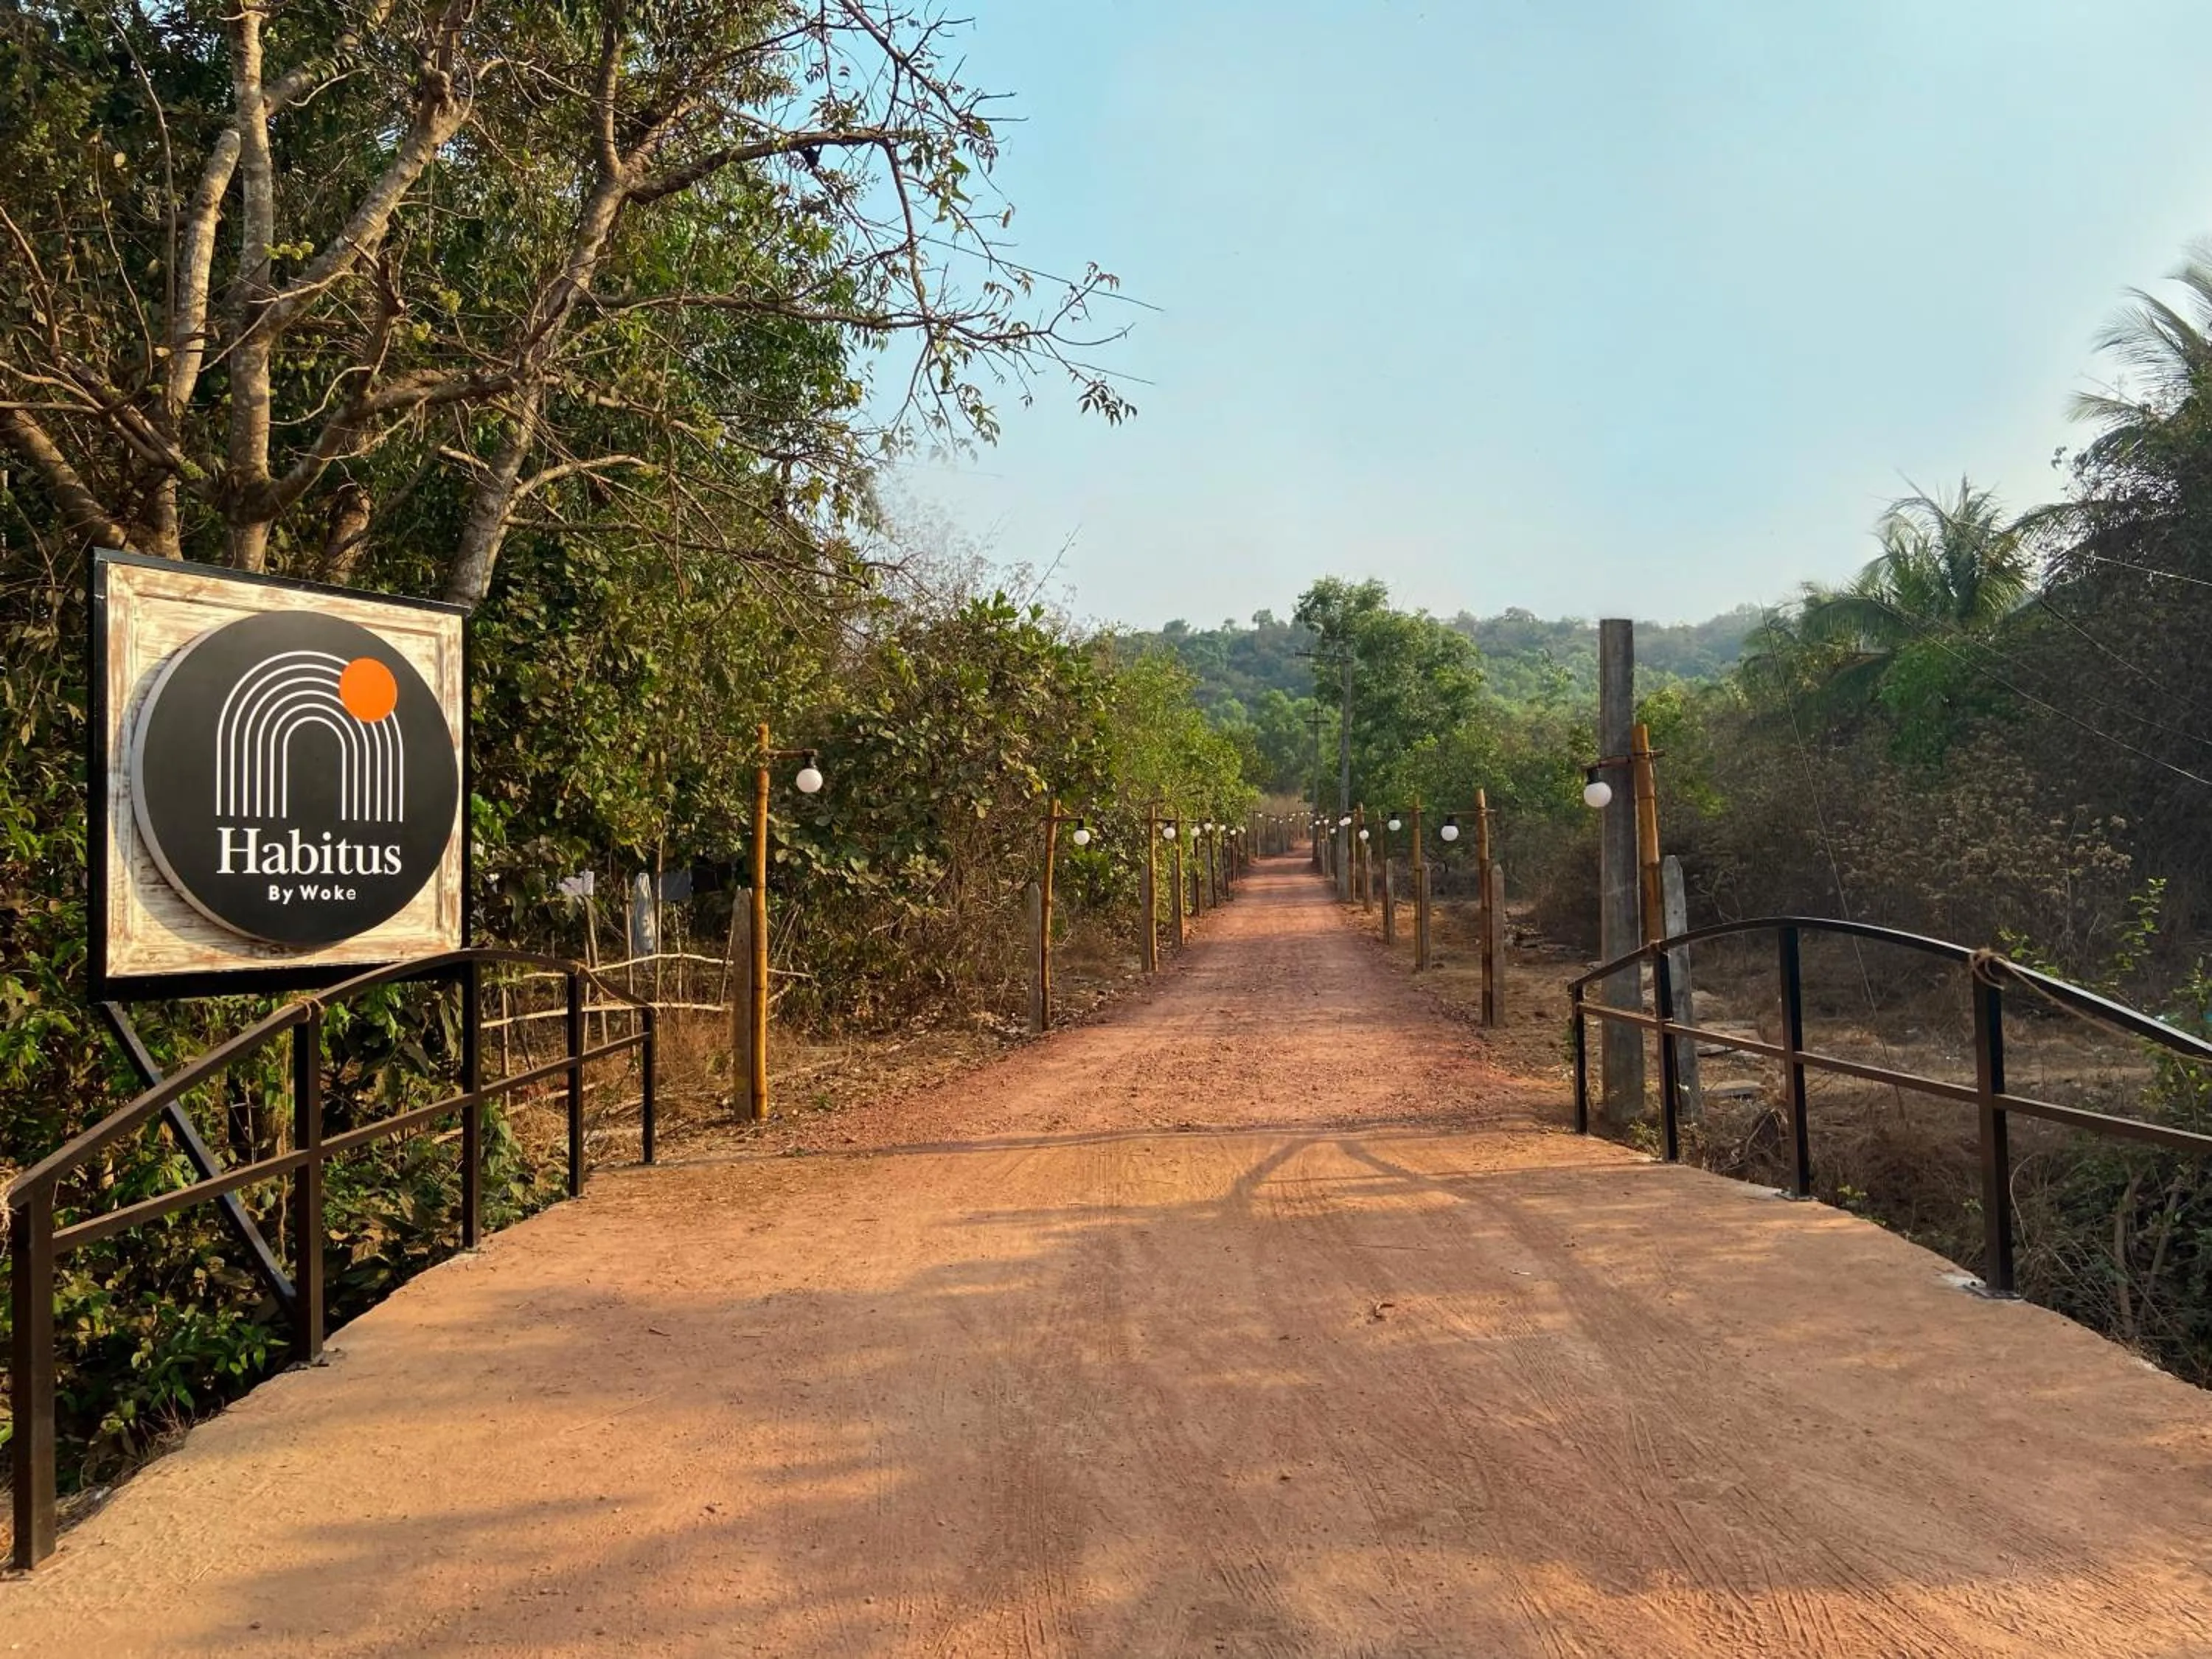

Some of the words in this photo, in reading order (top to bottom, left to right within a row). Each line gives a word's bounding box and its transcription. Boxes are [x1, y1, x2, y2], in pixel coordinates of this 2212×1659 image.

[215, 827, 402, 875] Habitus
[268, 884, 293, 905] By
[299, 884, 357, 901] Woke
